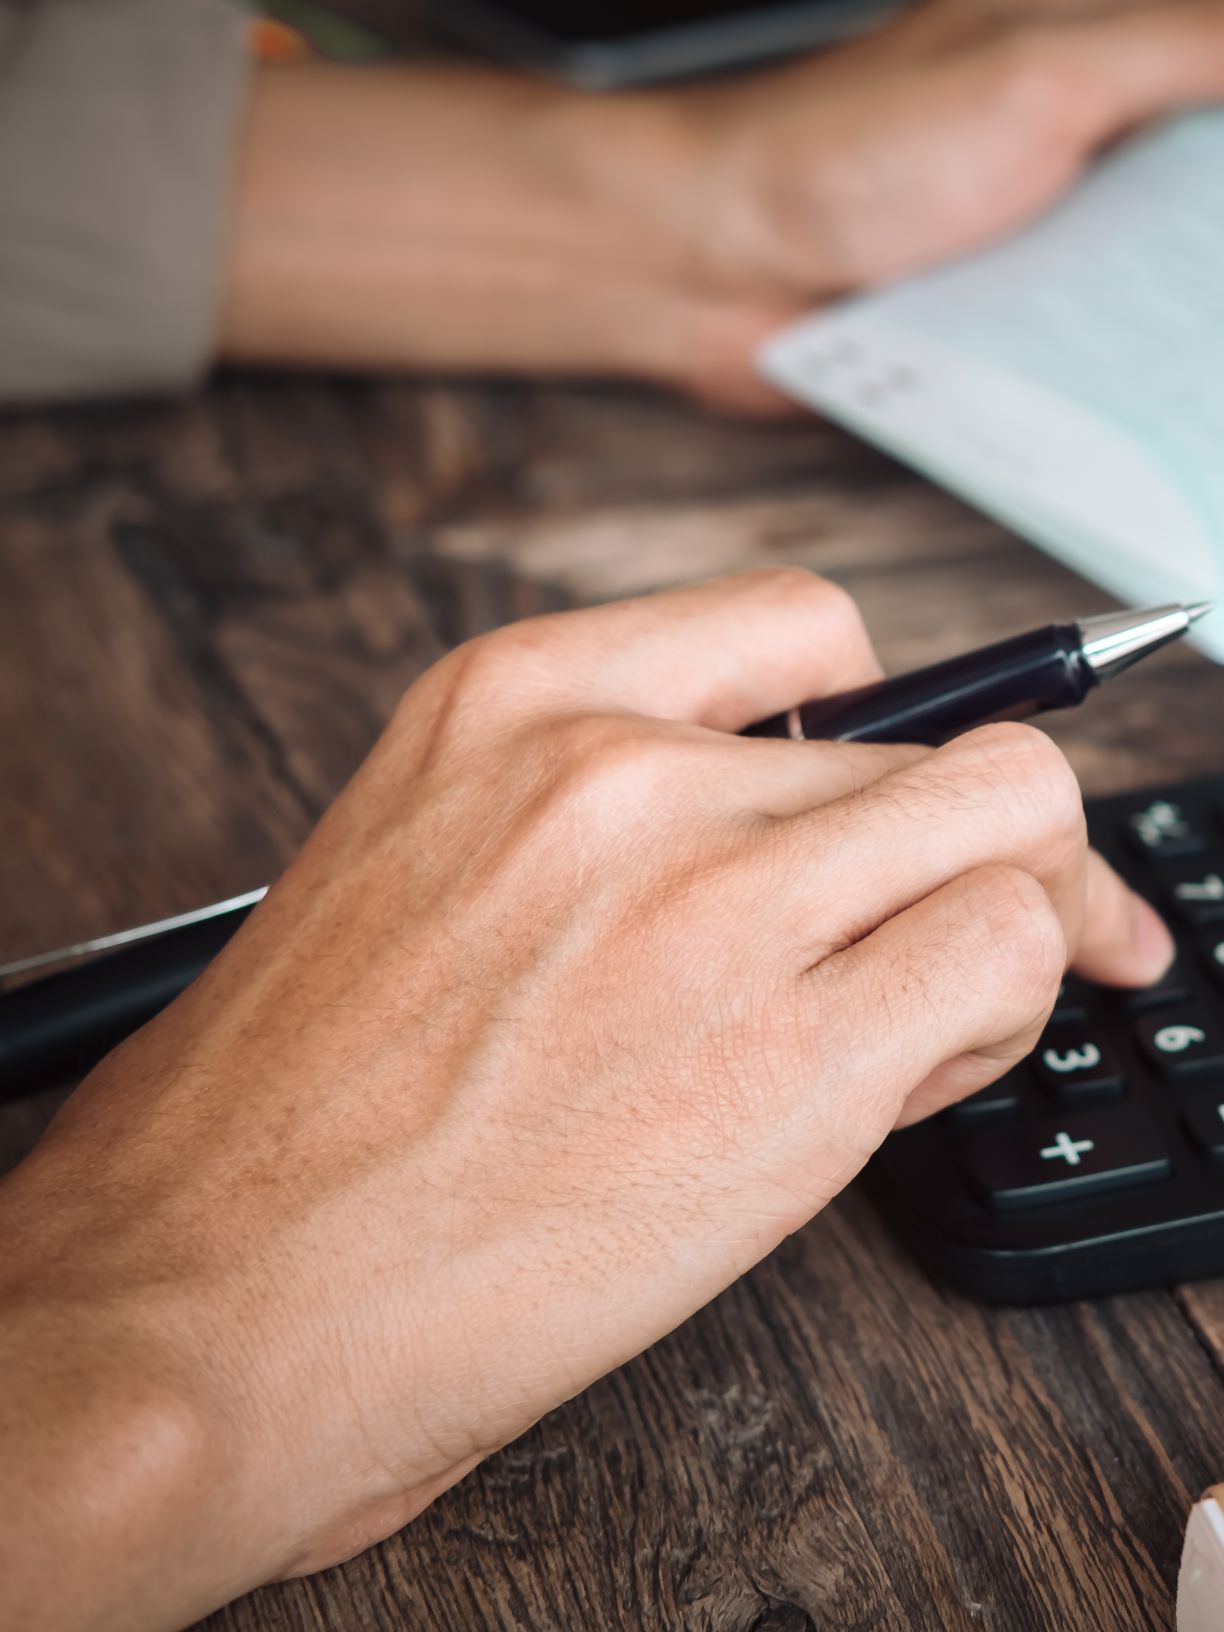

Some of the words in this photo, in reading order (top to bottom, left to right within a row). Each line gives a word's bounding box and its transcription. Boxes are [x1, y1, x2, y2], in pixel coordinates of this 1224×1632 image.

[1153, 1023, 1206, 1054] 6
[1042, 1043, 1102, 1074] 3
[1039, 1131, 1095, 1166] +
